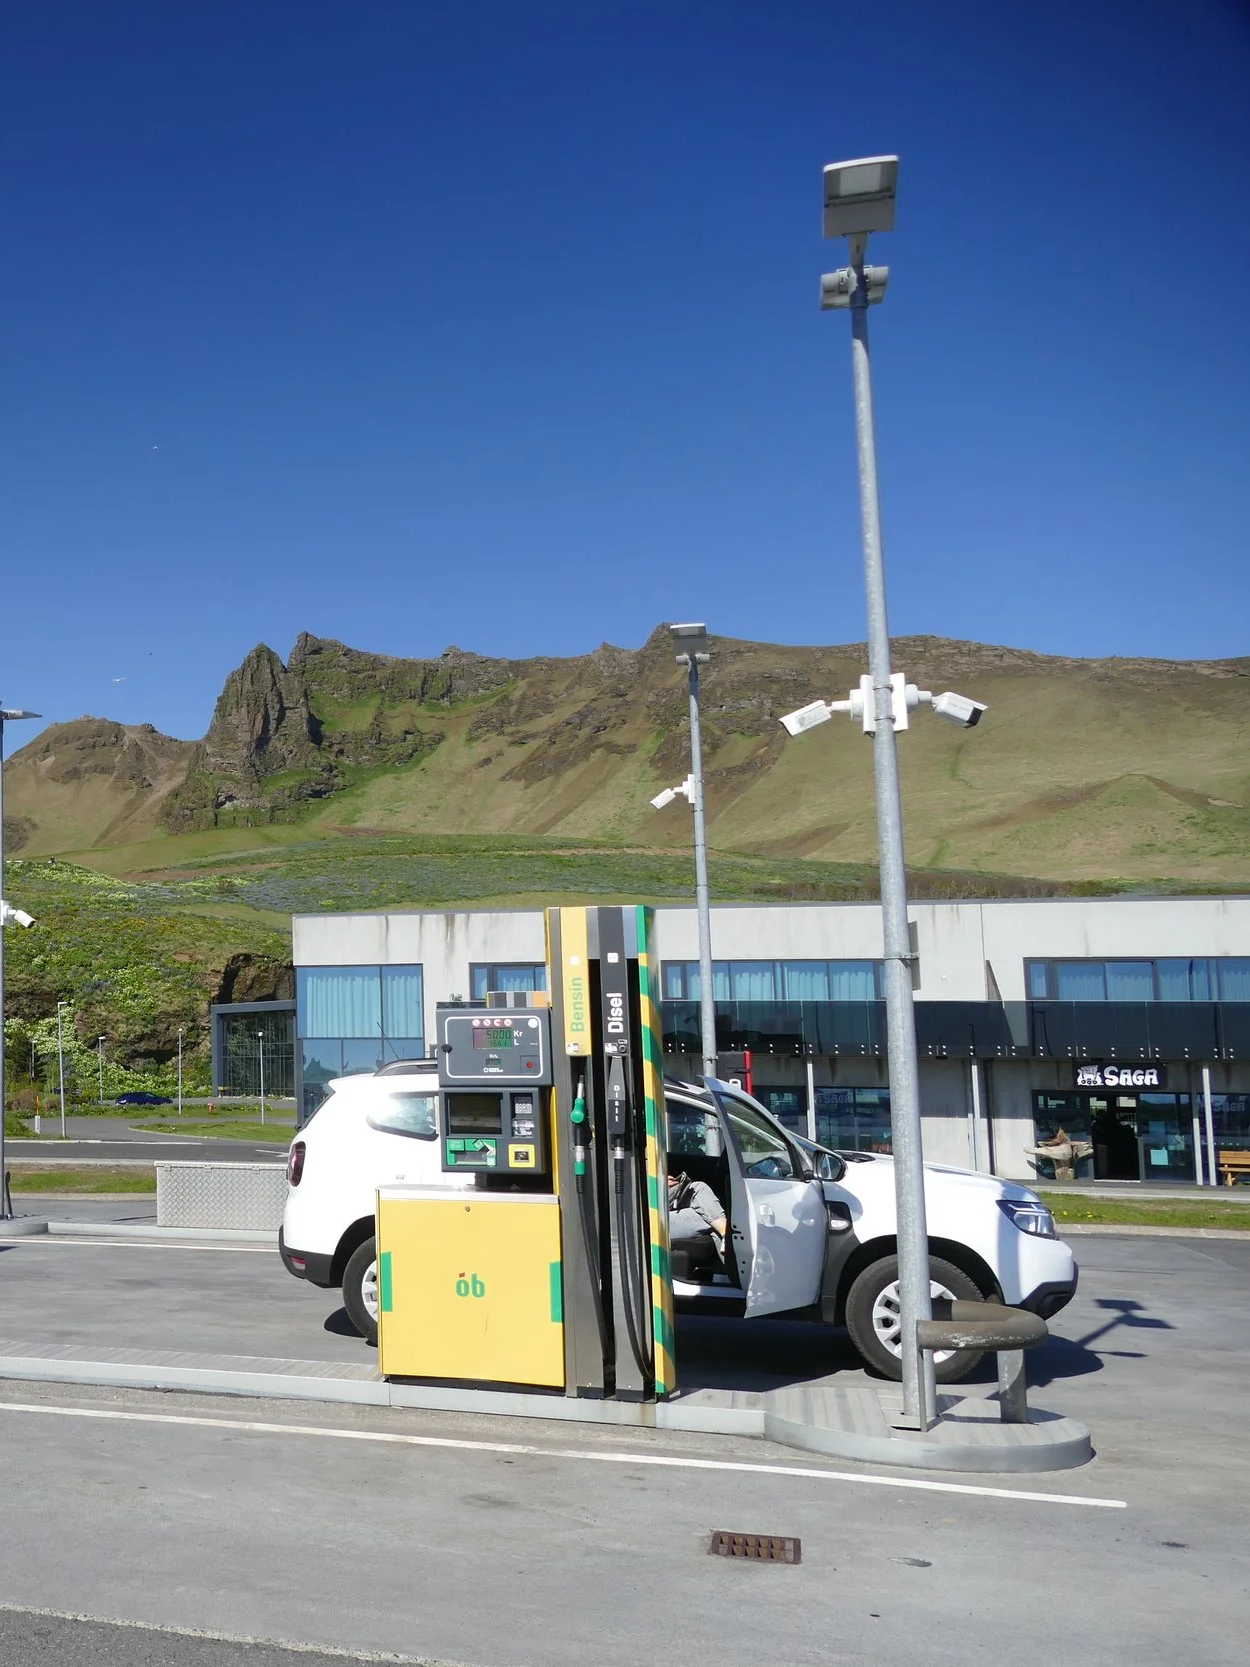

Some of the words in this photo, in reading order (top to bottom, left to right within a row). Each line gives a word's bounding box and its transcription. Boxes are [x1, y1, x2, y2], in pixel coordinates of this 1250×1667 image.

[486, 1030, 511, 1040] 5000
[513, 1030, 523, 1038] Kr
[513, 1038, 520, 1046] L
